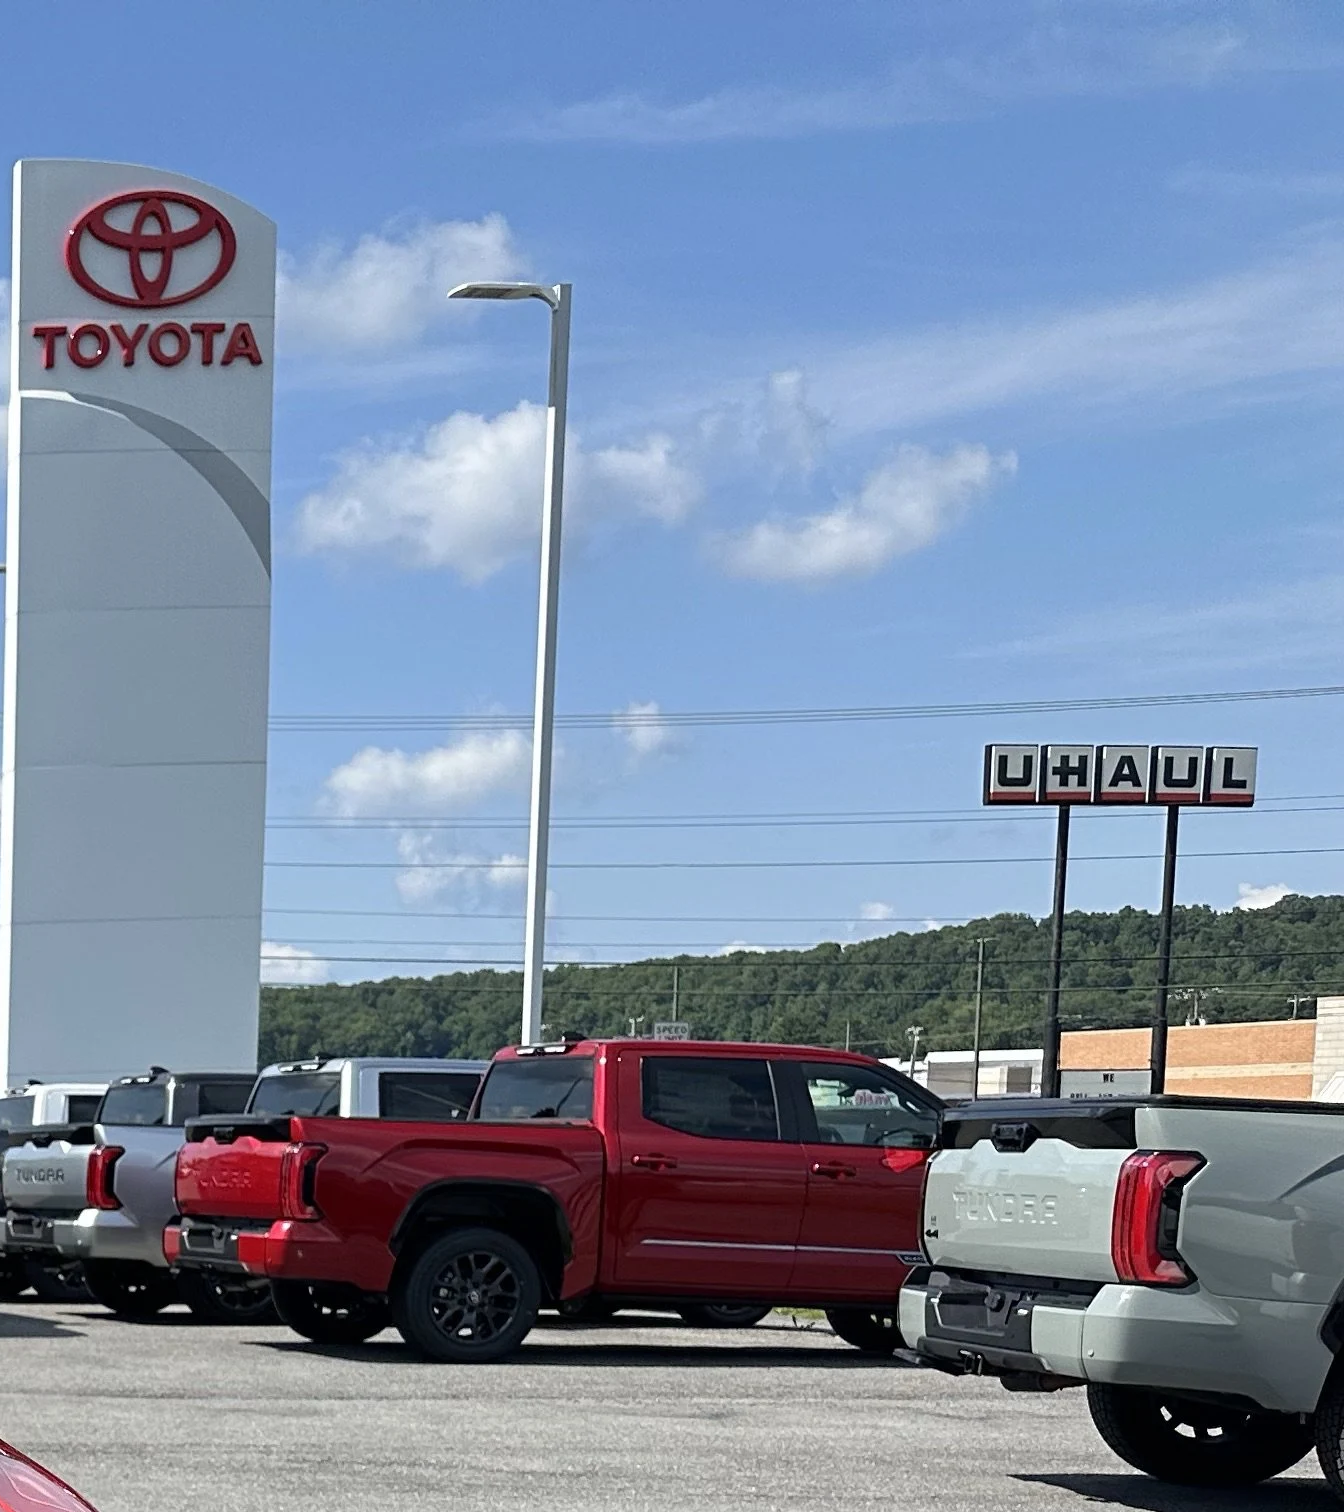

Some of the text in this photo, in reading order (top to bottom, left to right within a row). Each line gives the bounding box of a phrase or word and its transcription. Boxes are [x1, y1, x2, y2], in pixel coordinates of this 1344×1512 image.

[33, 323, 262, 369] TOYOTA
[1103, 1073, 1114, 1083] WE
[952, 1190, 1058, 1225] TUNDRA
